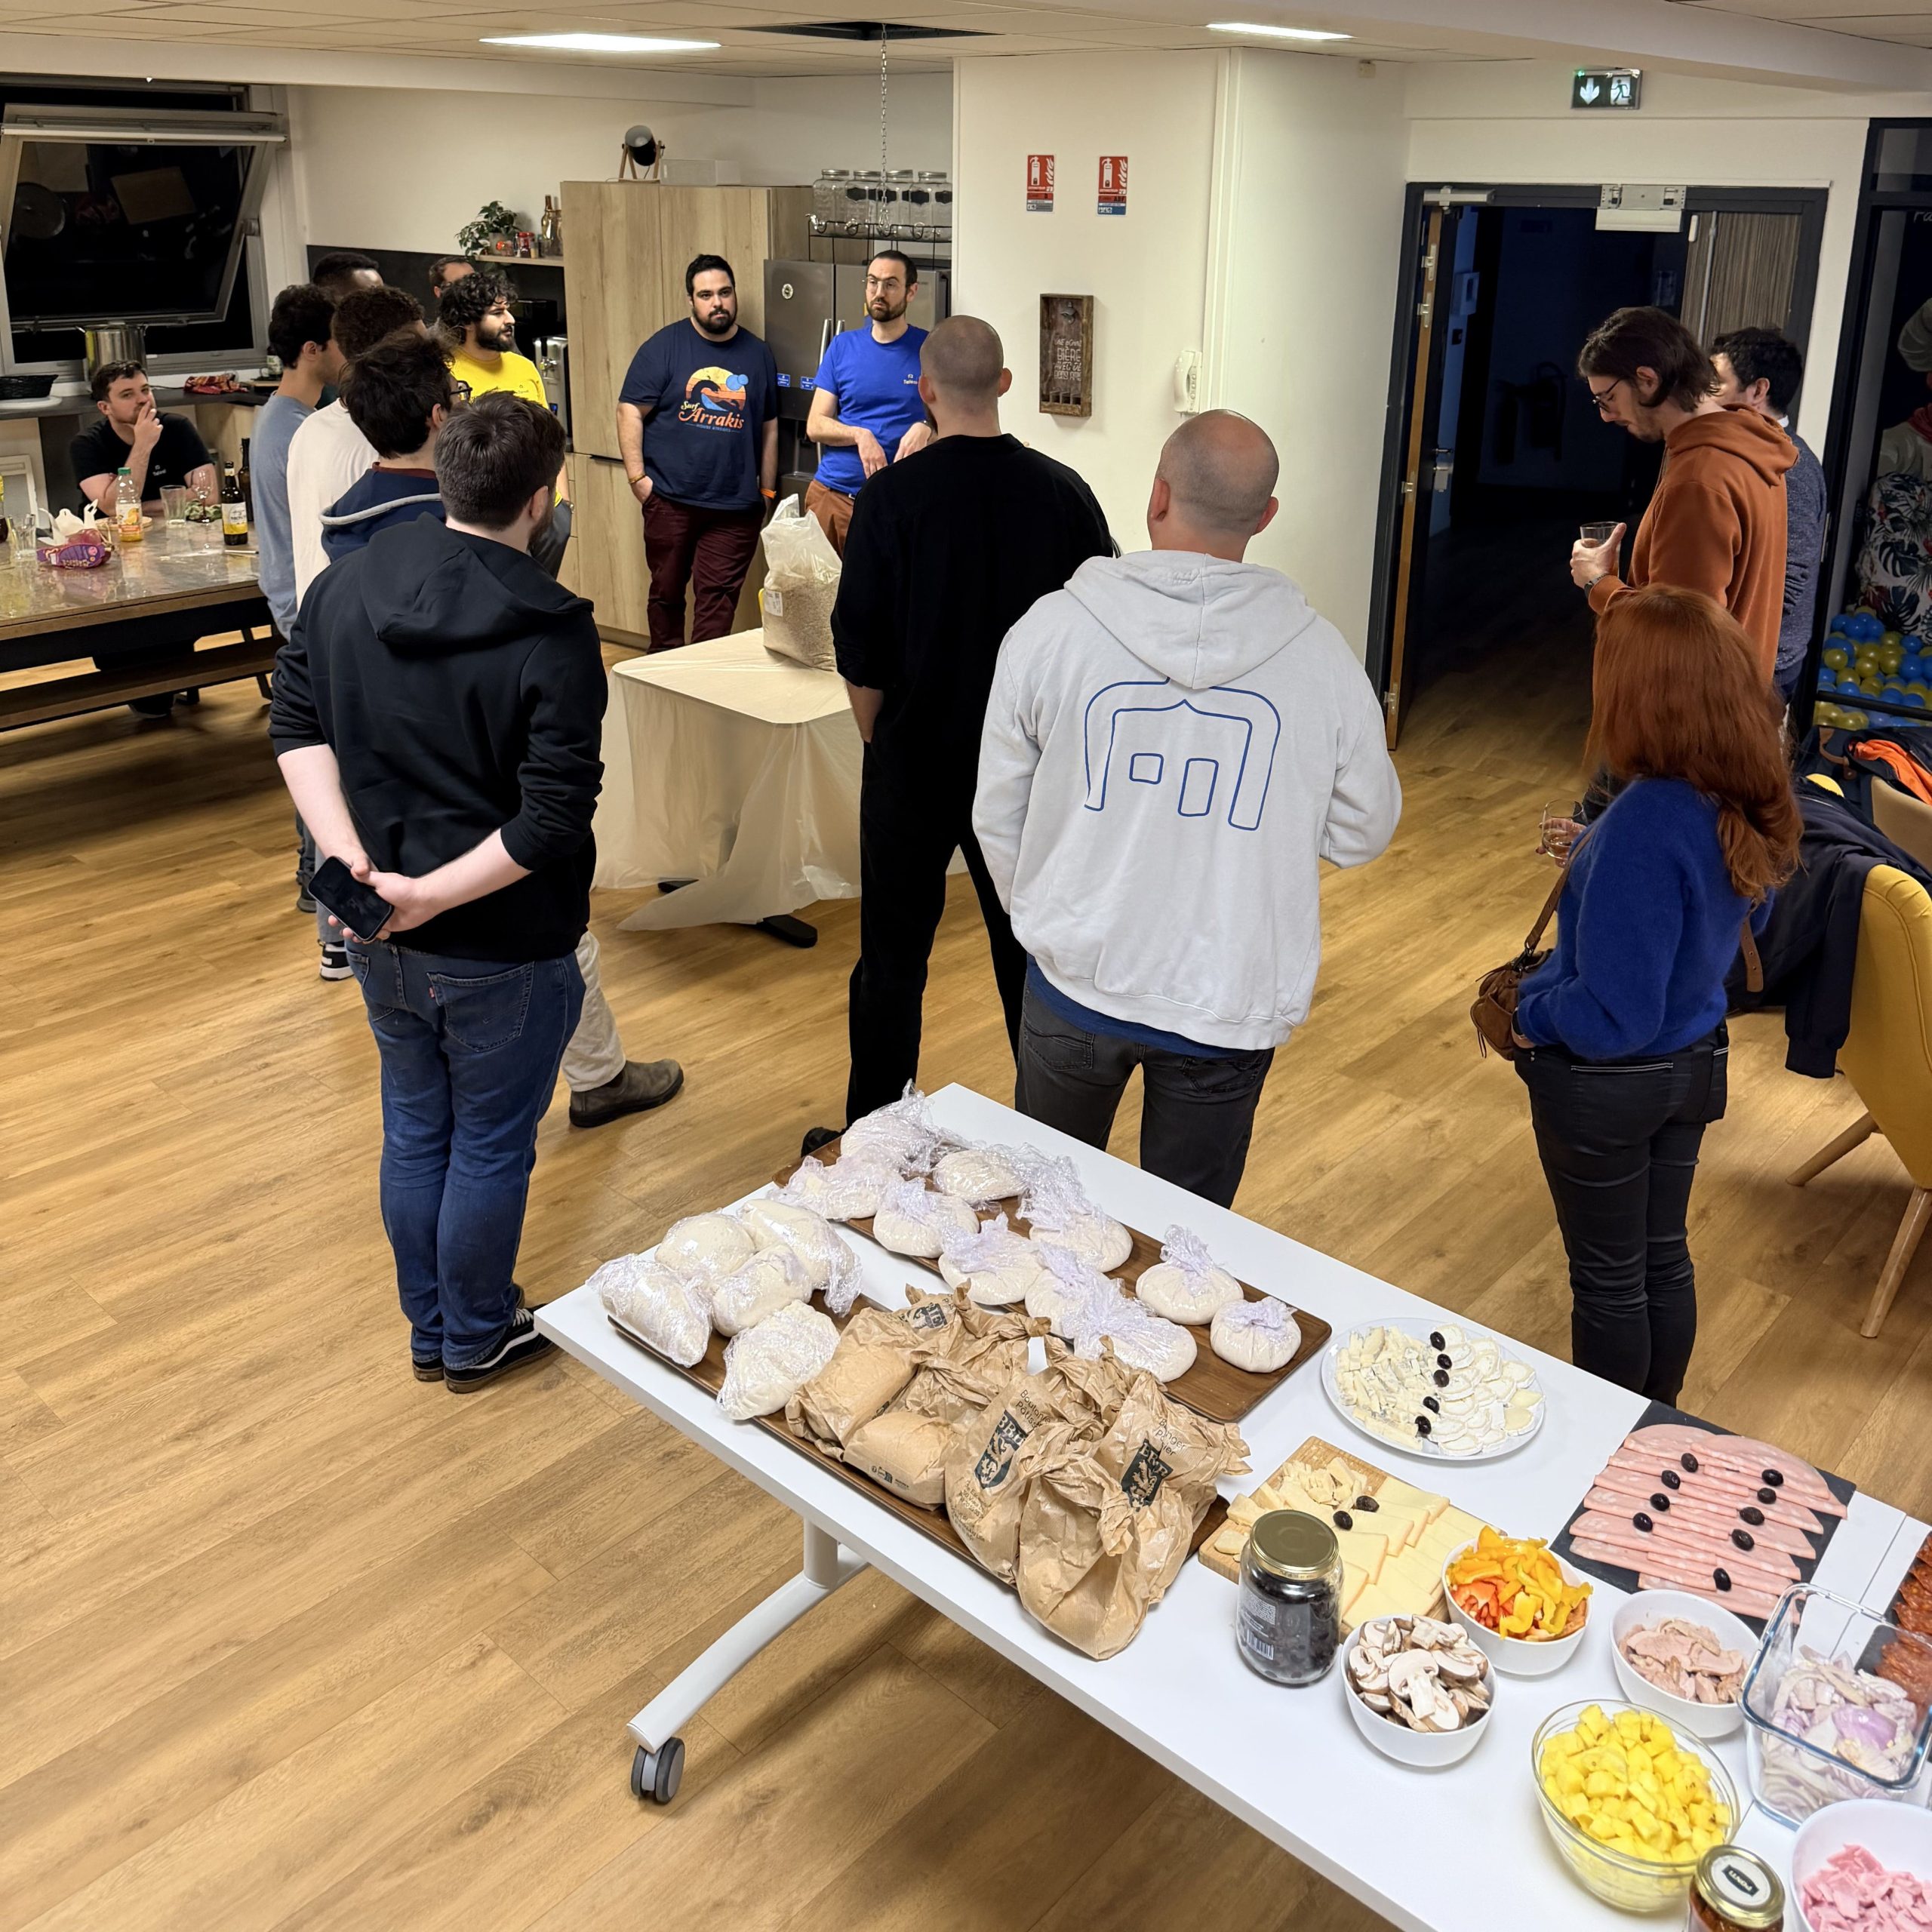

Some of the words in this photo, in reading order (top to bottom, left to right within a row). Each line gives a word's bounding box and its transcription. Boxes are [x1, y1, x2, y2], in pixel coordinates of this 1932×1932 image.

[1057, 346, 1081, 361] BIÈRE
[681, 401, 700, 412] Surf
[678, 408, 744, 429] Arrakis
[1727, 1870, 1752, 1891] PONTI
